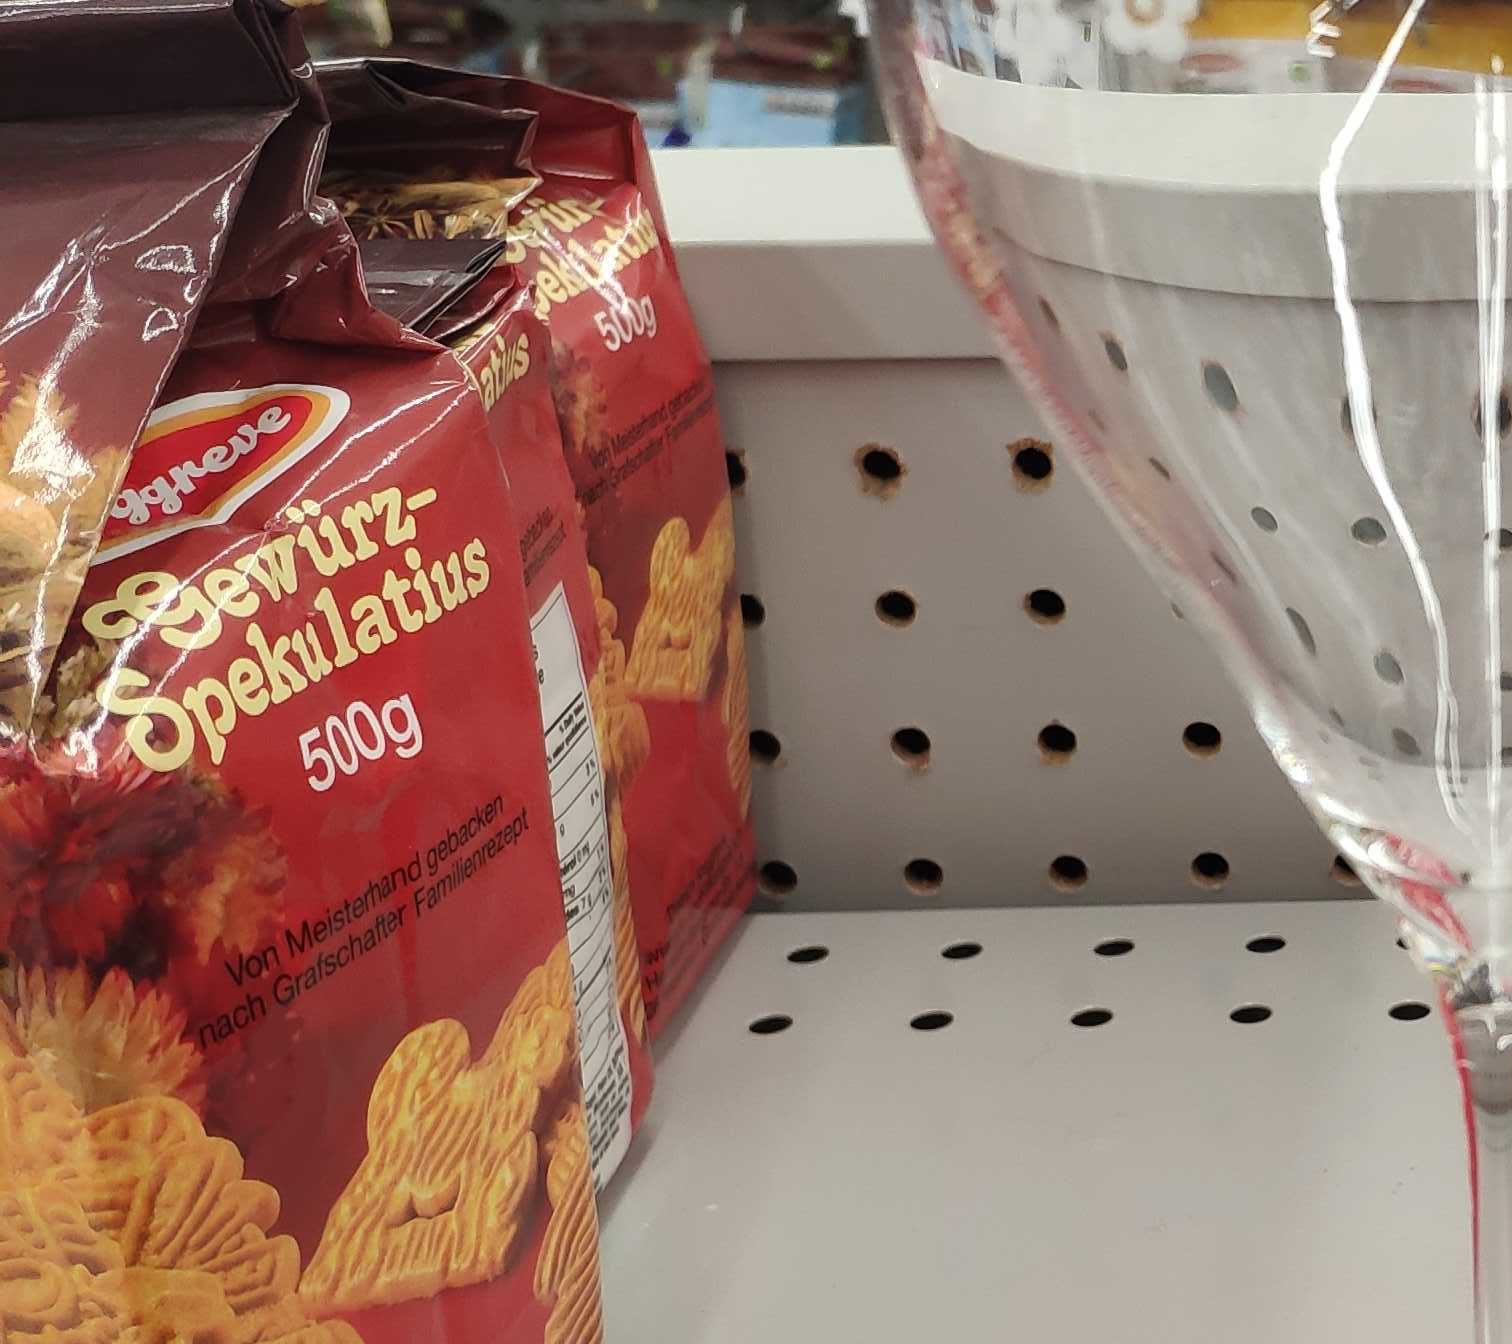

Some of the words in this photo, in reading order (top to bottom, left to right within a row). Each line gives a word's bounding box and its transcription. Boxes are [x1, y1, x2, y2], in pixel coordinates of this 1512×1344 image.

[593, 295, 657, 352] 500g
[82, 486, 438, 650] Gewürz-
[96, 537, 491, 774] Spekulatius
[298, 693, 424, 793] 500g
[198, 993, 267, 1051] nach
[272, 905, 408, 1007] Grafschafter
[413, 807, 531, 918] Familienrezept
[224, 945, 281, 988] Von
[284, 851, 423, 958] Meisterhand
[426, 794, 505, 878] gebacken
